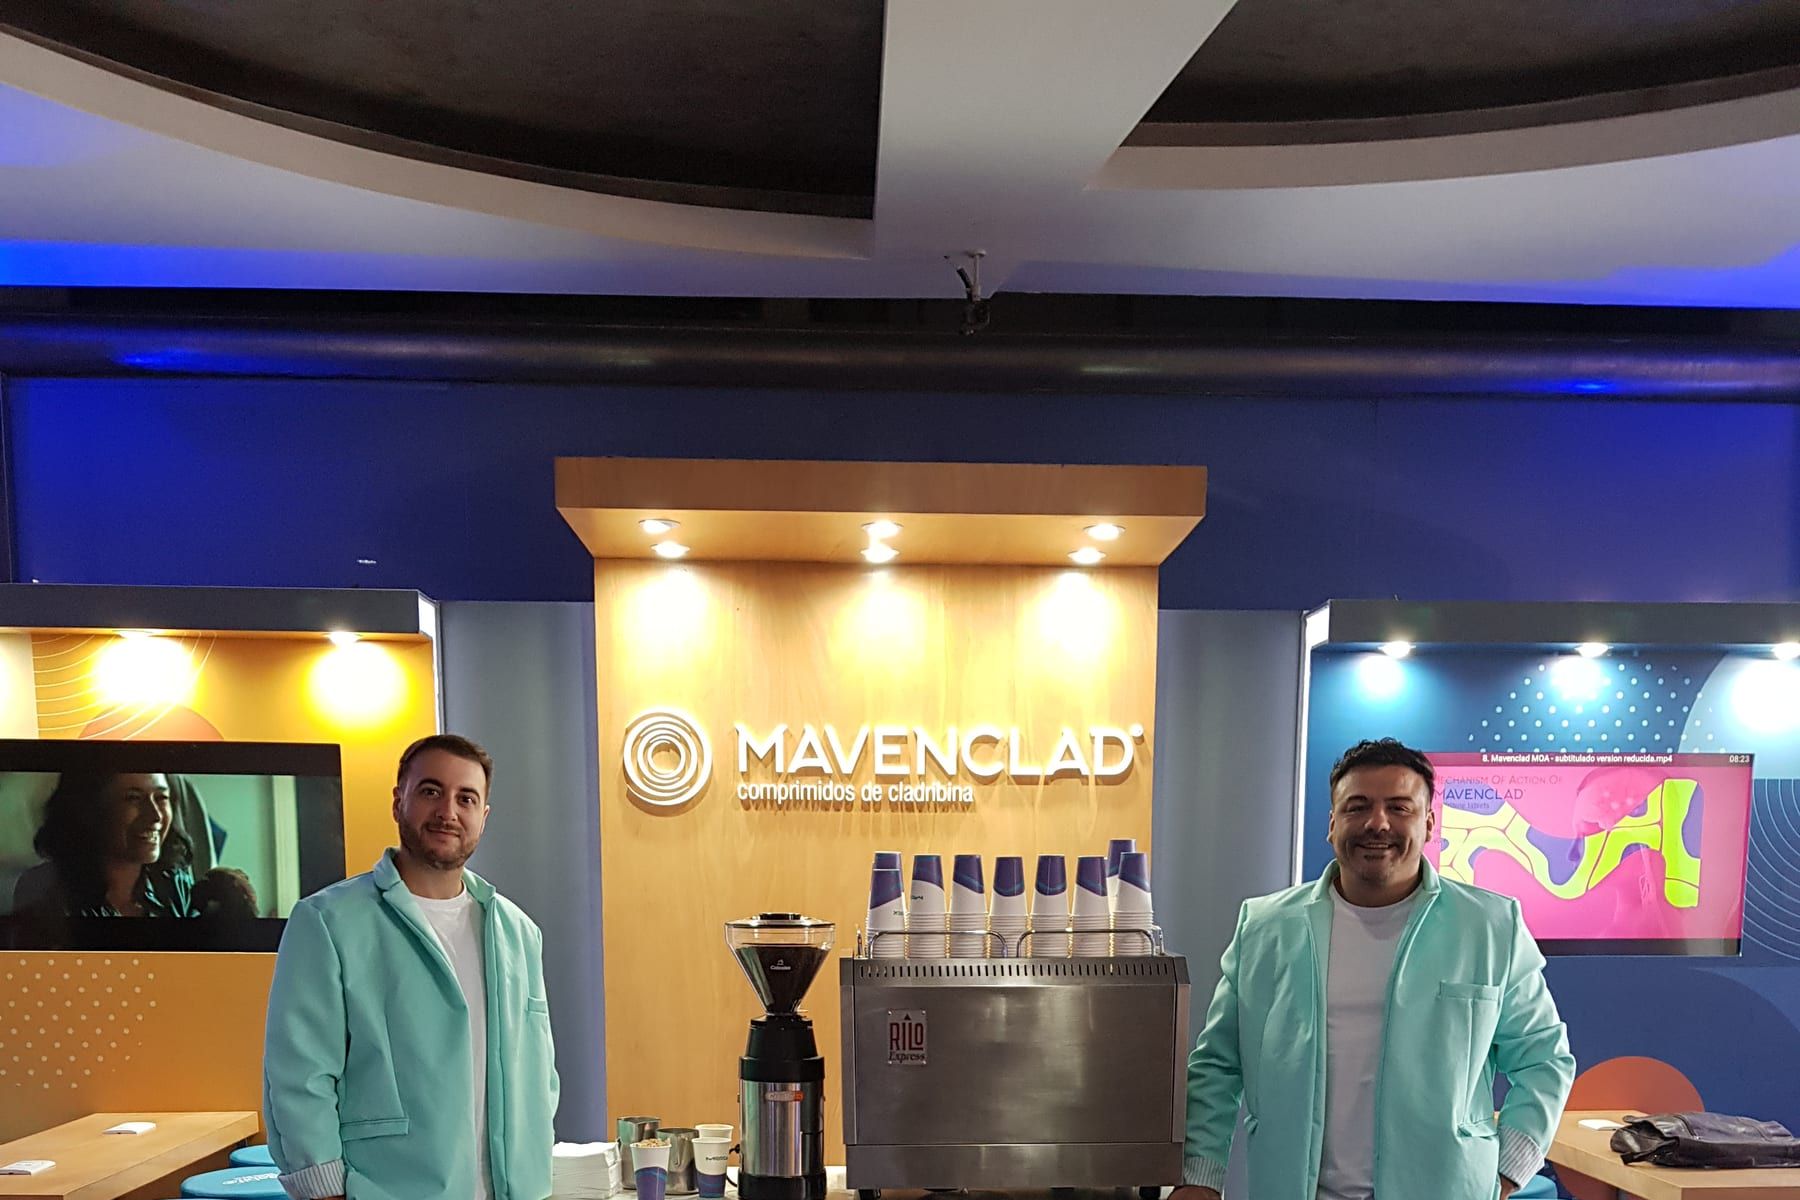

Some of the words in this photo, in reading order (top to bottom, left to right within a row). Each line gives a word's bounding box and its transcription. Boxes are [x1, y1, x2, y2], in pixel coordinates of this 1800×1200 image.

[1482, 754, 1489, 763] 8.
[1491, 754, 1530, 763] Mavenclad
[1531, 754, 1550, 763] MOA
[1555, 754, 1595, 763] subtitulado
[1596, 755, 1623, 763] version
[1623, 754, 1673, 764] reducida.mp4
[1729, 755, 1750, 763] 08:23
[737, 780, 855, 804] comprimidos
[861, 781, 882, 801] de
[888, 781, 973, 802] cladribina
[890, 1022, 924, 1051] RILO
